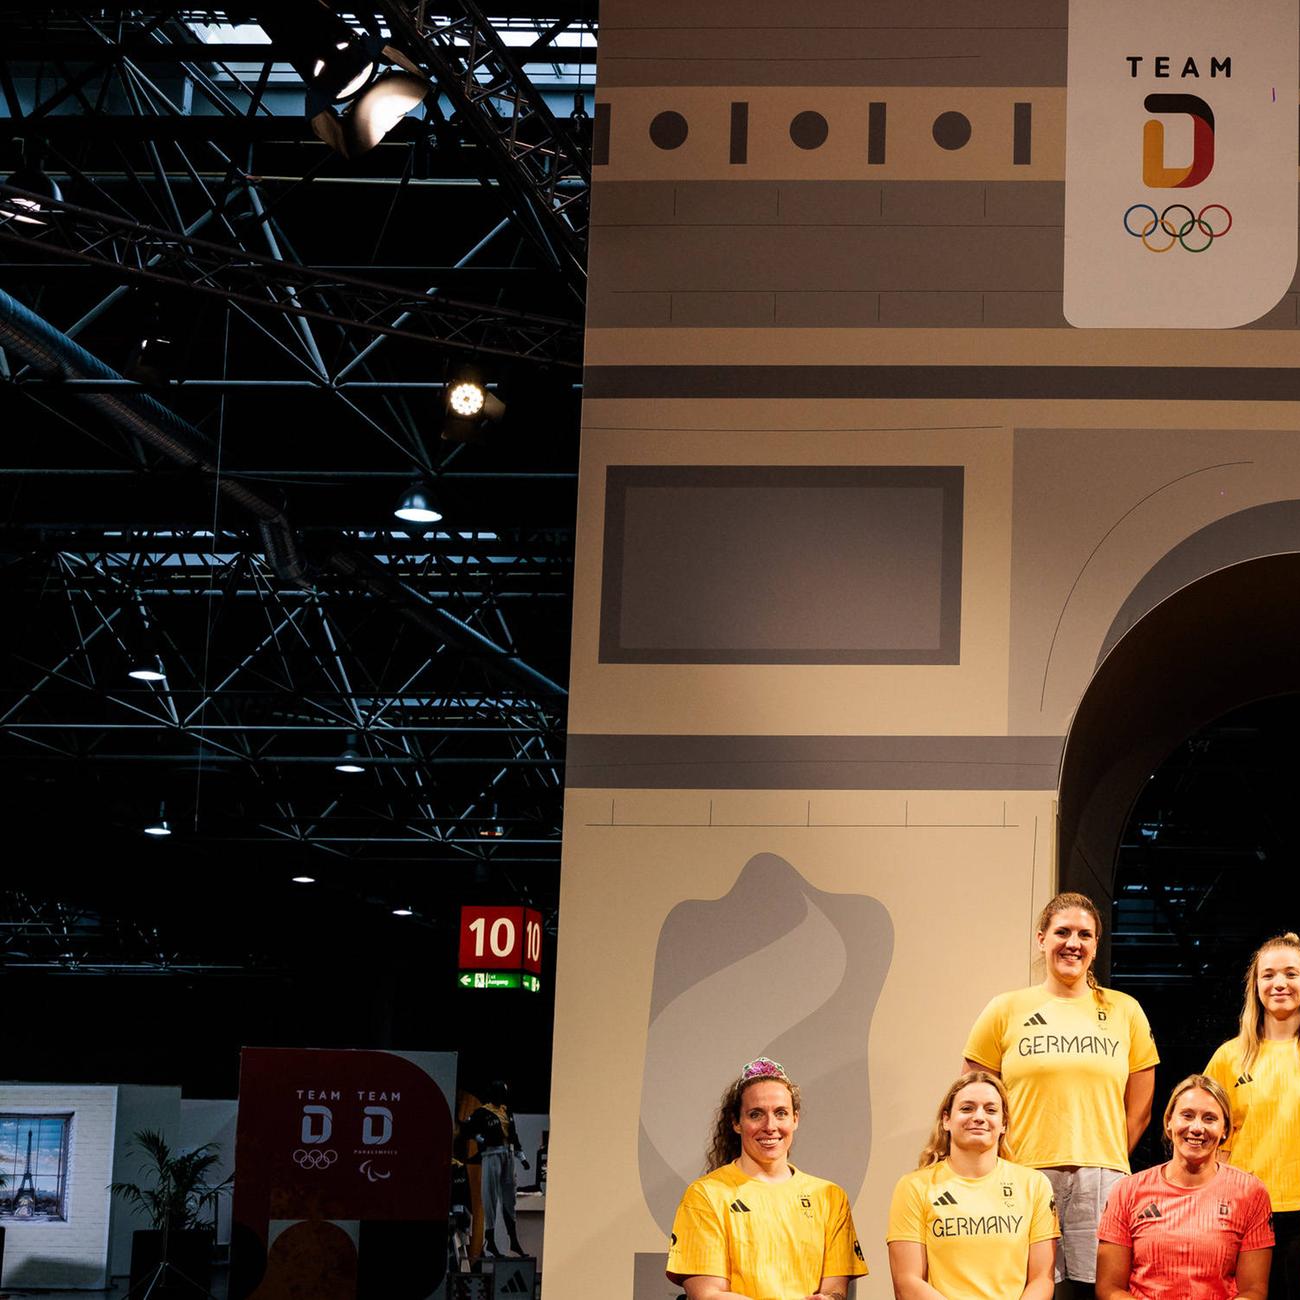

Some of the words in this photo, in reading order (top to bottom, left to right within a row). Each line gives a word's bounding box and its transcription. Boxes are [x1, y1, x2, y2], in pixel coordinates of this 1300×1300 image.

[1126, 56, 1233, 79] TEAM
[468, 917, 516, 957] 10
[526, 921, 541, 962] 10
[1018, 1035, 1119, 1057] GERMANY
[296, 1089, 341, 1101] TEAM
[357, 1091, 401, 1102] TEAM
[932, 1215, 1024, 1238] GERMANY
